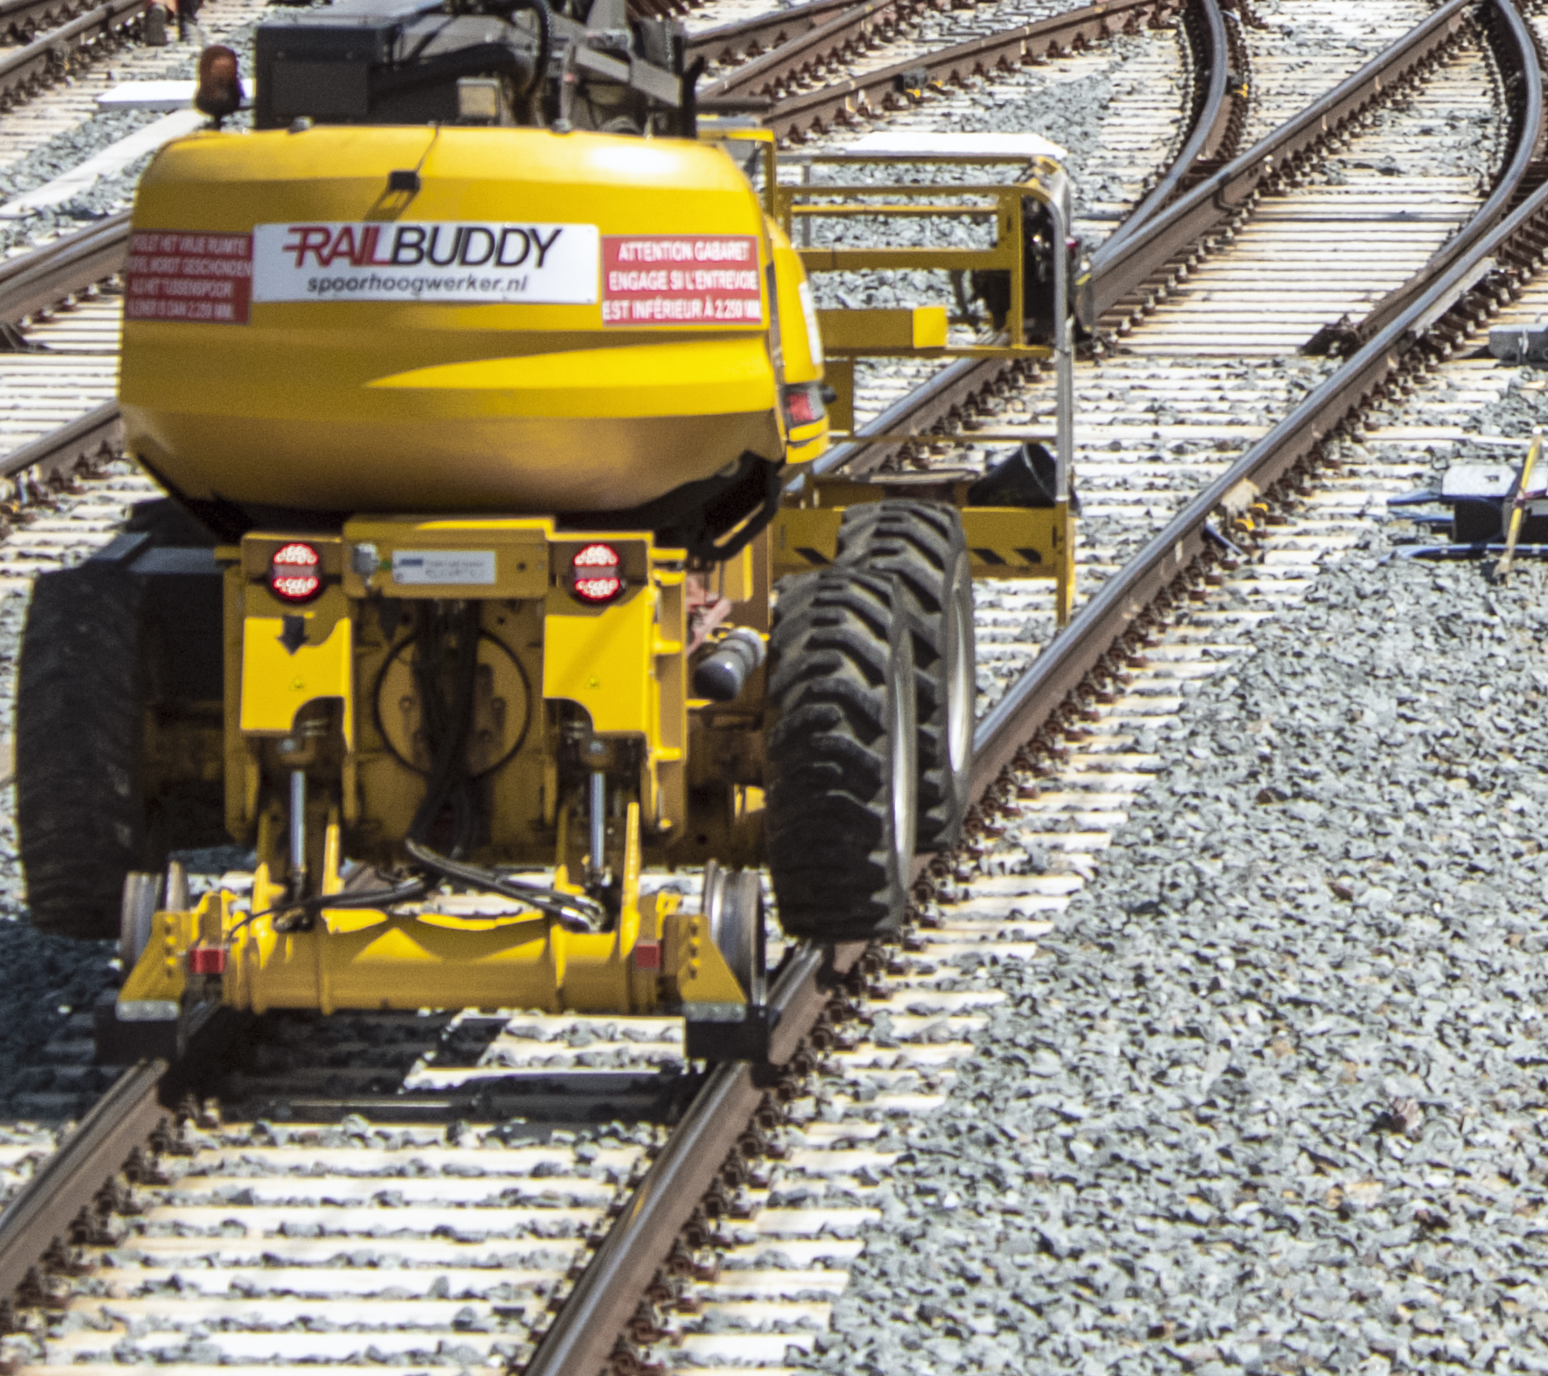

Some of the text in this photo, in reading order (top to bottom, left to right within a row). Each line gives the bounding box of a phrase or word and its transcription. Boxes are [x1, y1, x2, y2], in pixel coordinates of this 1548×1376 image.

[282, 225, 563, 269] RAILBUDDY
[617, 241, 693, 262] ATTENTION
[307, 274, 529, 296] spoorhoogwerker.nl
[608, 270, 669, 291] ENGAGE
[670, 270, 684, 290] SI
[602, 299, 631, 321] EST
[632, 295, 703, 320] INFÉRIEUR
[703, 295, 715, 319] À
